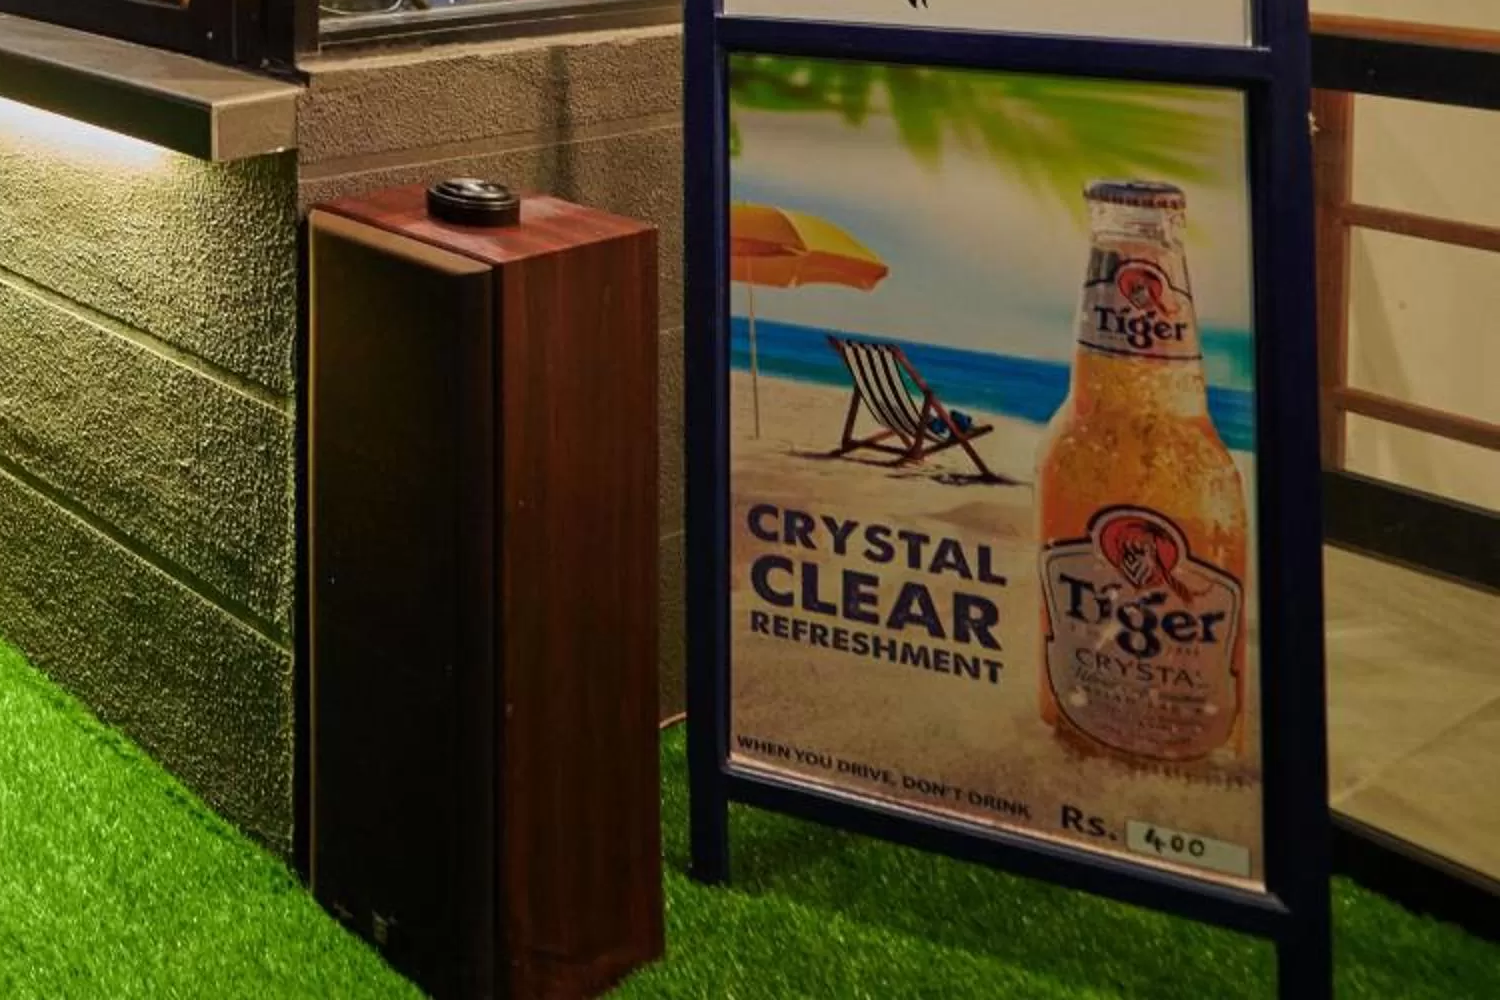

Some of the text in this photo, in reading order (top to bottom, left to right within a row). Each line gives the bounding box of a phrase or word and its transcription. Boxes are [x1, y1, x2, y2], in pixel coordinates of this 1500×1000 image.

[1093, 304, 1189, 349] Tiger
[747, 503, 1007, 587] CRYSTAL
[751, 554, 1003, 652] CLEAR
[1059, 573, 1226, 658] Tiger
[751, 610, 1004, 684] REFRESHMENT
[737, 734, 1032, 820] WHEN YOU DRIVE, DON'T DRINK
[1060, 804, 1206, 857] Rs. 400
